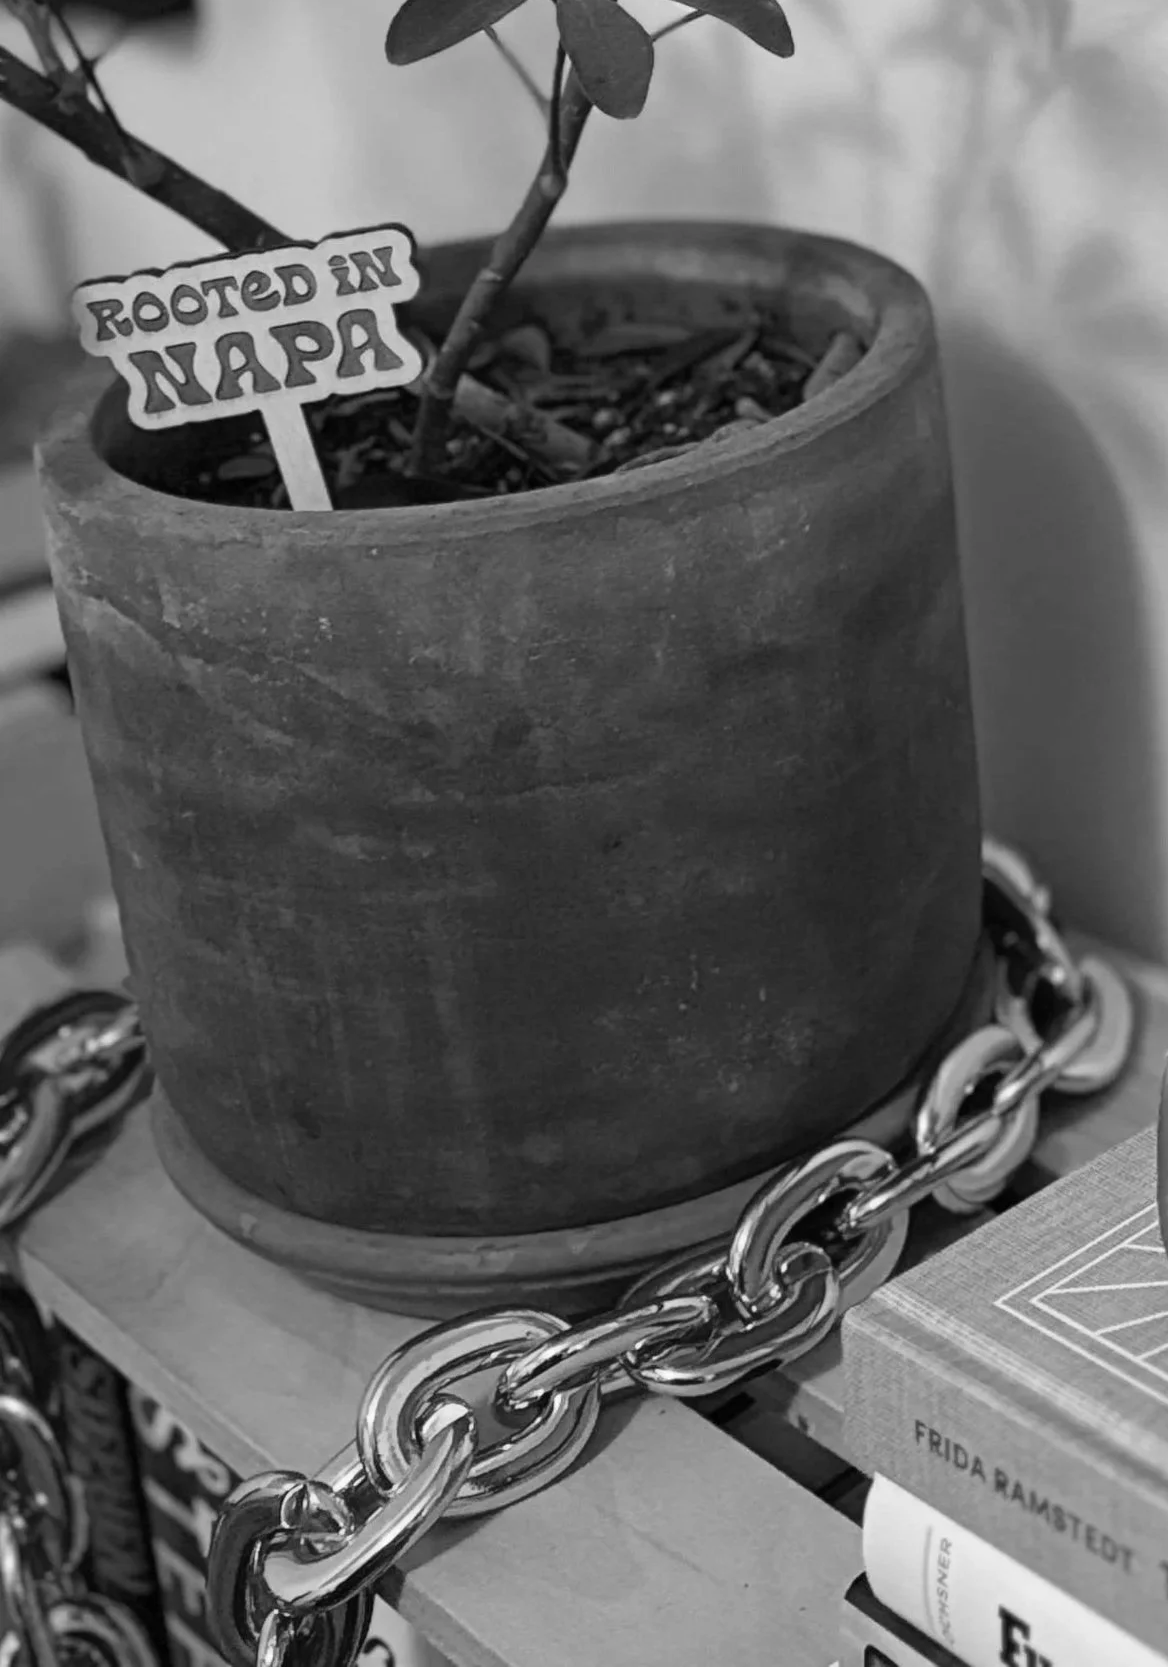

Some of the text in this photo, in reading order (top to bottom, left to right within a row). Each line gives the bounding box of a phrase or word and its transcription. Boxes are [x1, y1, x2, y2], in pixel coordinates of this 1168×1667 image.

[128, 308, 404, 414] NAPA
[914, 1419, 986, 1483] FRIDA
[994, 1467, 1133, 1575] RAMSTEDT
